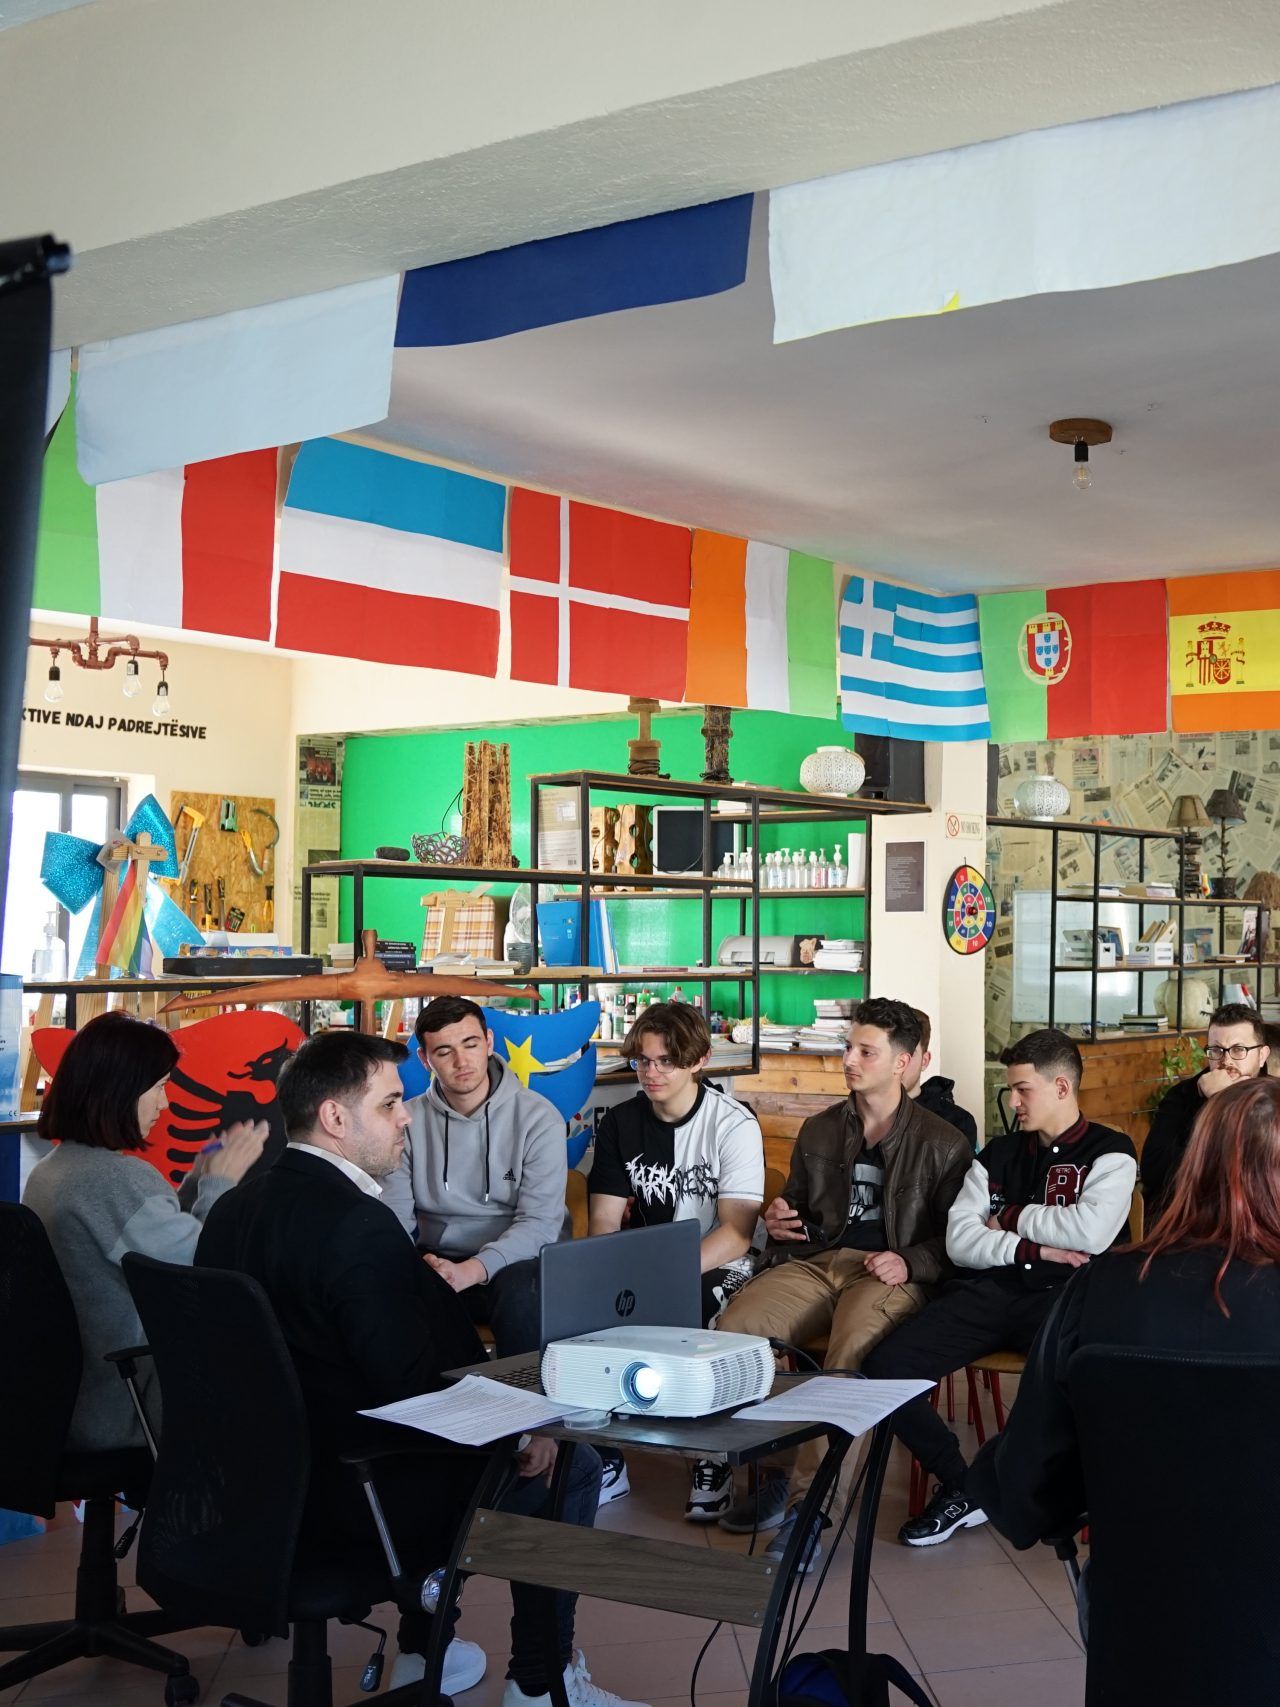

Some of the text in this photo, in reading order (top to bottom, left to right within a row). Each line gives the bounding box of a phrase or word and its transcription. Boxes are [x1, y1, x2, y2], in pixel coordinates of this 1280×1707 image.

[65, 712, 104, 729] NDAJ
[107, 717, 207, 740] PADREJTËSIVE
[616, 1289, 635, 1318] hp
